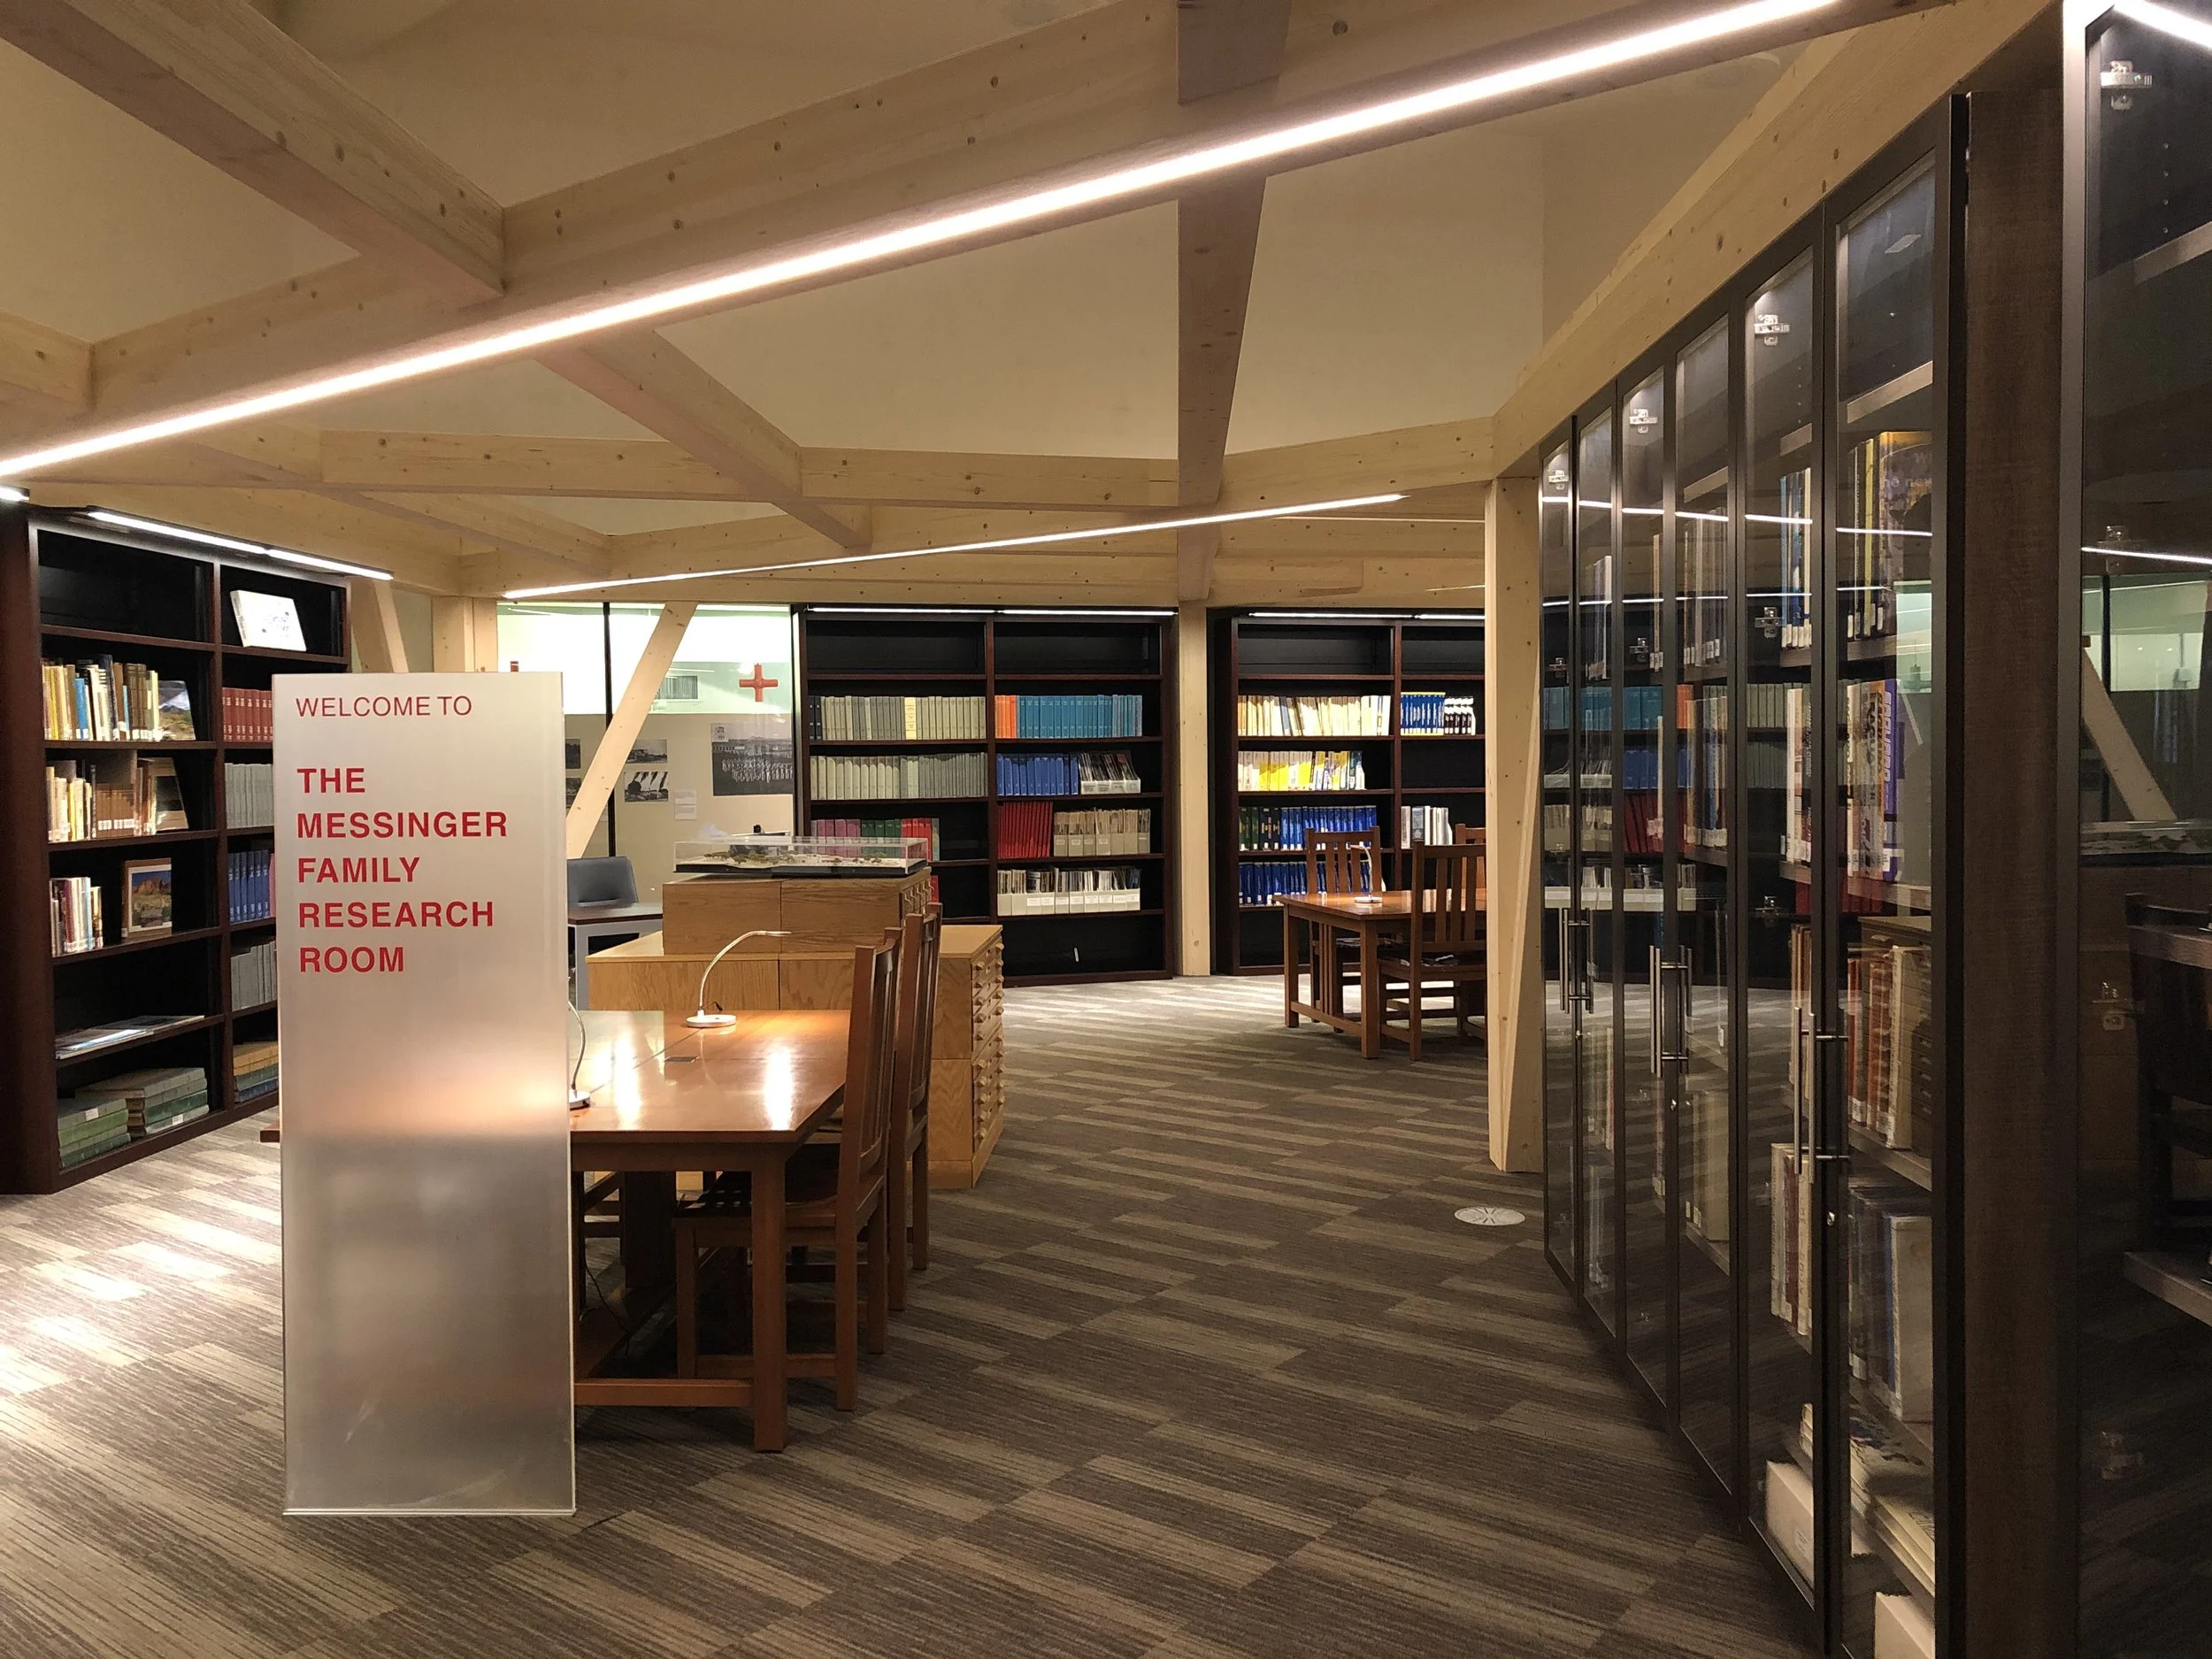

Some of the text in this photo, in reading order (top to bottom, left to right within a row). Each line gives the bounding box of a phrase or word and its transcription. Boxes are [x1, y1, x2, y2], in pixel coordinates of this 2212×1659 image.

[296, 695, 431, 718] WELCOME
[436, 695, 472, 717] TO
[296, 767, 365, 794] THE
[297, 810, 508, 839] MESSINGER
[298, 856, 420, 883] FAMILY
[299, 901, 494, 928] RESEARCH
[299, 946, 404, 973] ROOM
